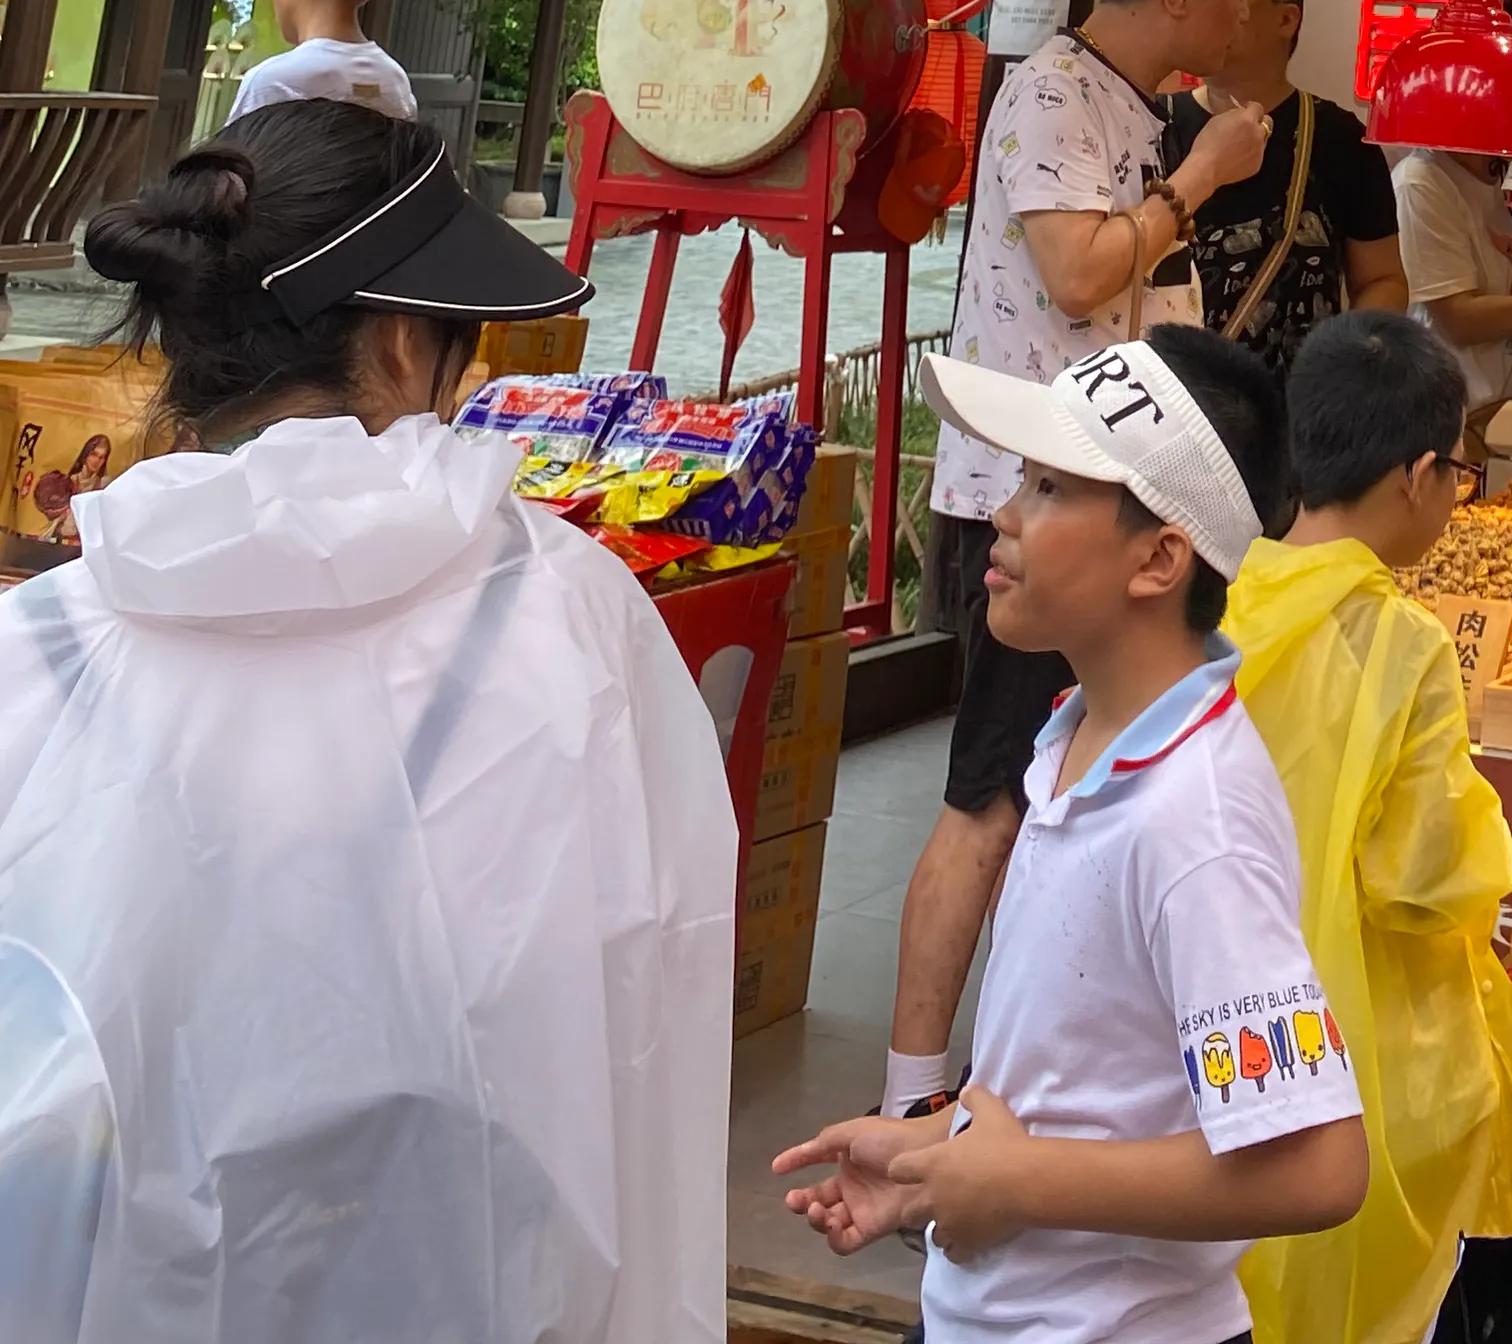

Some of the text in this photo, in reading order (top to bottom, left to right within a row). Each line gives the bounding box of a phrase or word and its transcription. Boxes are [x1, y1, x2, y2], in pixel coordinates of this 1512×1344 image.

[1071, 346, 1166, 434] RT
[1192, 1007, 1215, 1032] SKY
[1218, 1002, 1231, 1022] IS
[1233, 992, 1266, 1016] VERY
[1268, 985, 1301, 1009] BLUE
